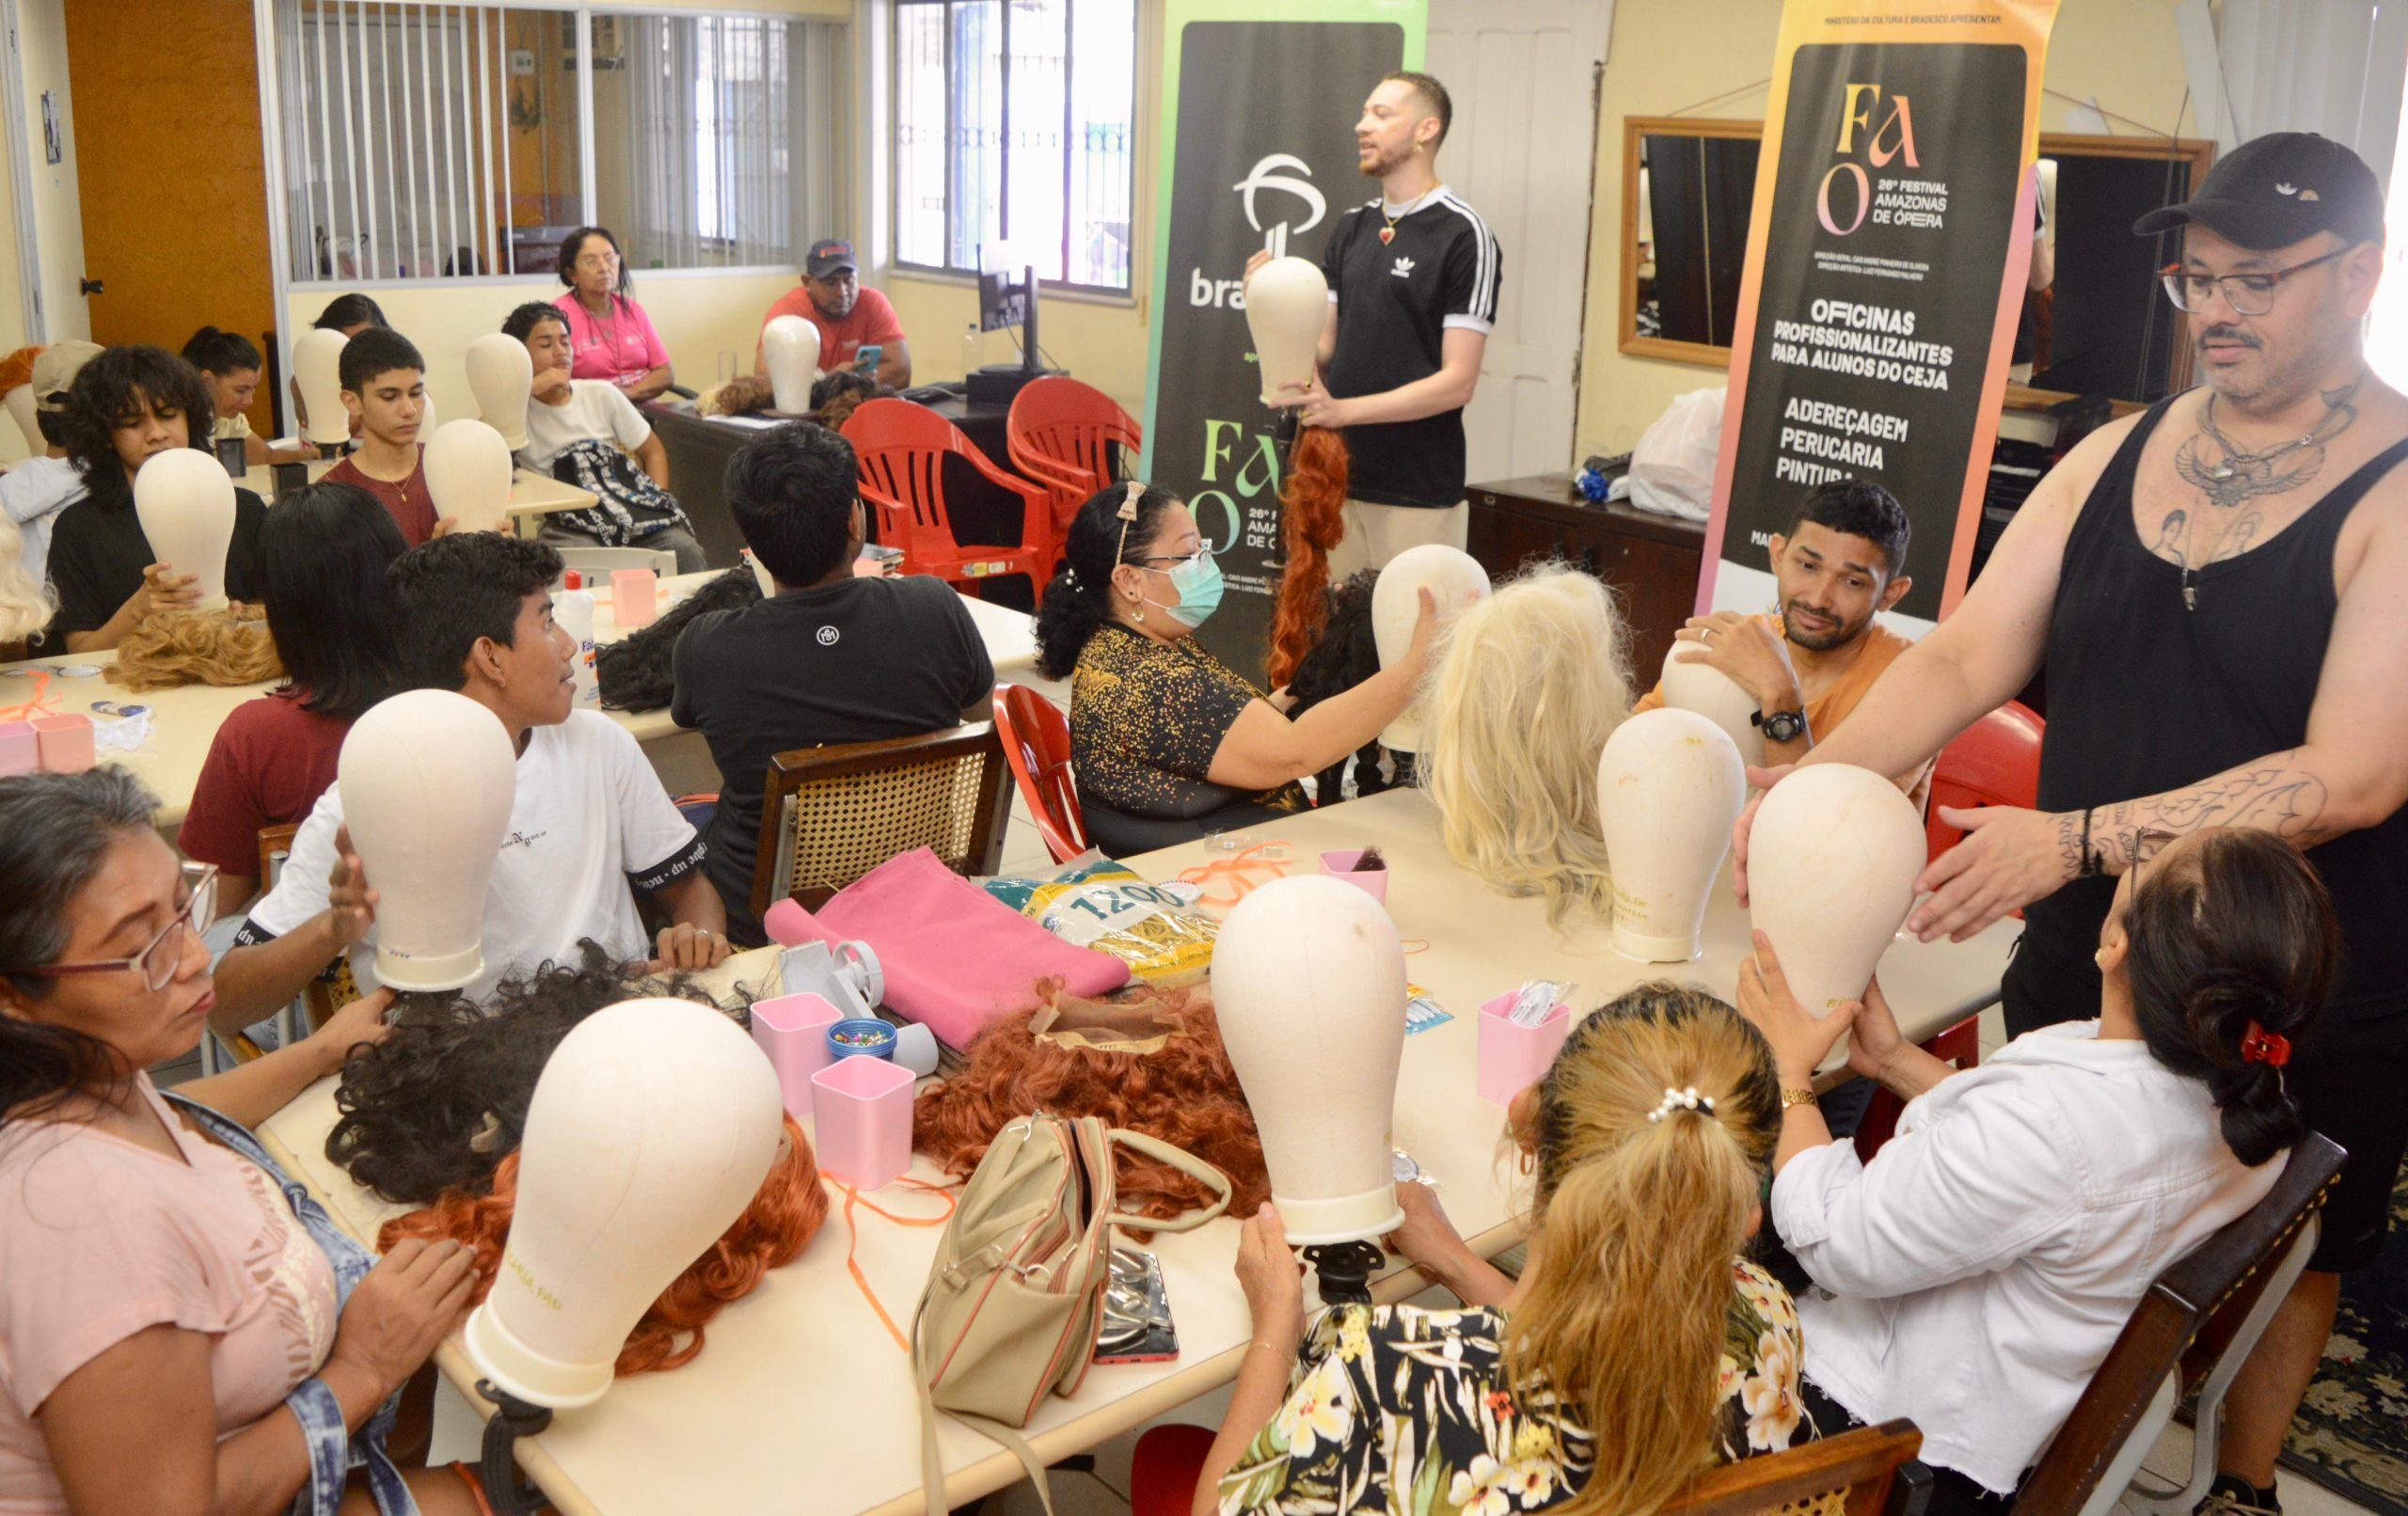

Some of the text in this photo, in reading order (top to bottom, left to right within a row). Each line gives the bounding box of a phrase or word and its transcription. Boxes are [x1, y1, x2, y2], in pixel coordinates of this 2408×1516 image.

[1875, 193, 1947, 212] AMAZONAS
[1899, 180, 1948, 195] FESTIVAL
[1872, 209, 1943, 229] DE ÓPERA
[1811, 298, 1916, 336] OFICINAS
[1773, 321, 1953, 367] PROFISSIONALIZANTES
[1771, 343, 1949, 391] PARA ALUNOS DO CEJA
[1784, 397, 1909, 443] ADEREÇAGEM
[1781, 427, 1884, 470] PERUCARIA
[1246, 534, 1265, 548] DE
[1070, 885, 1185, 920] 1200
